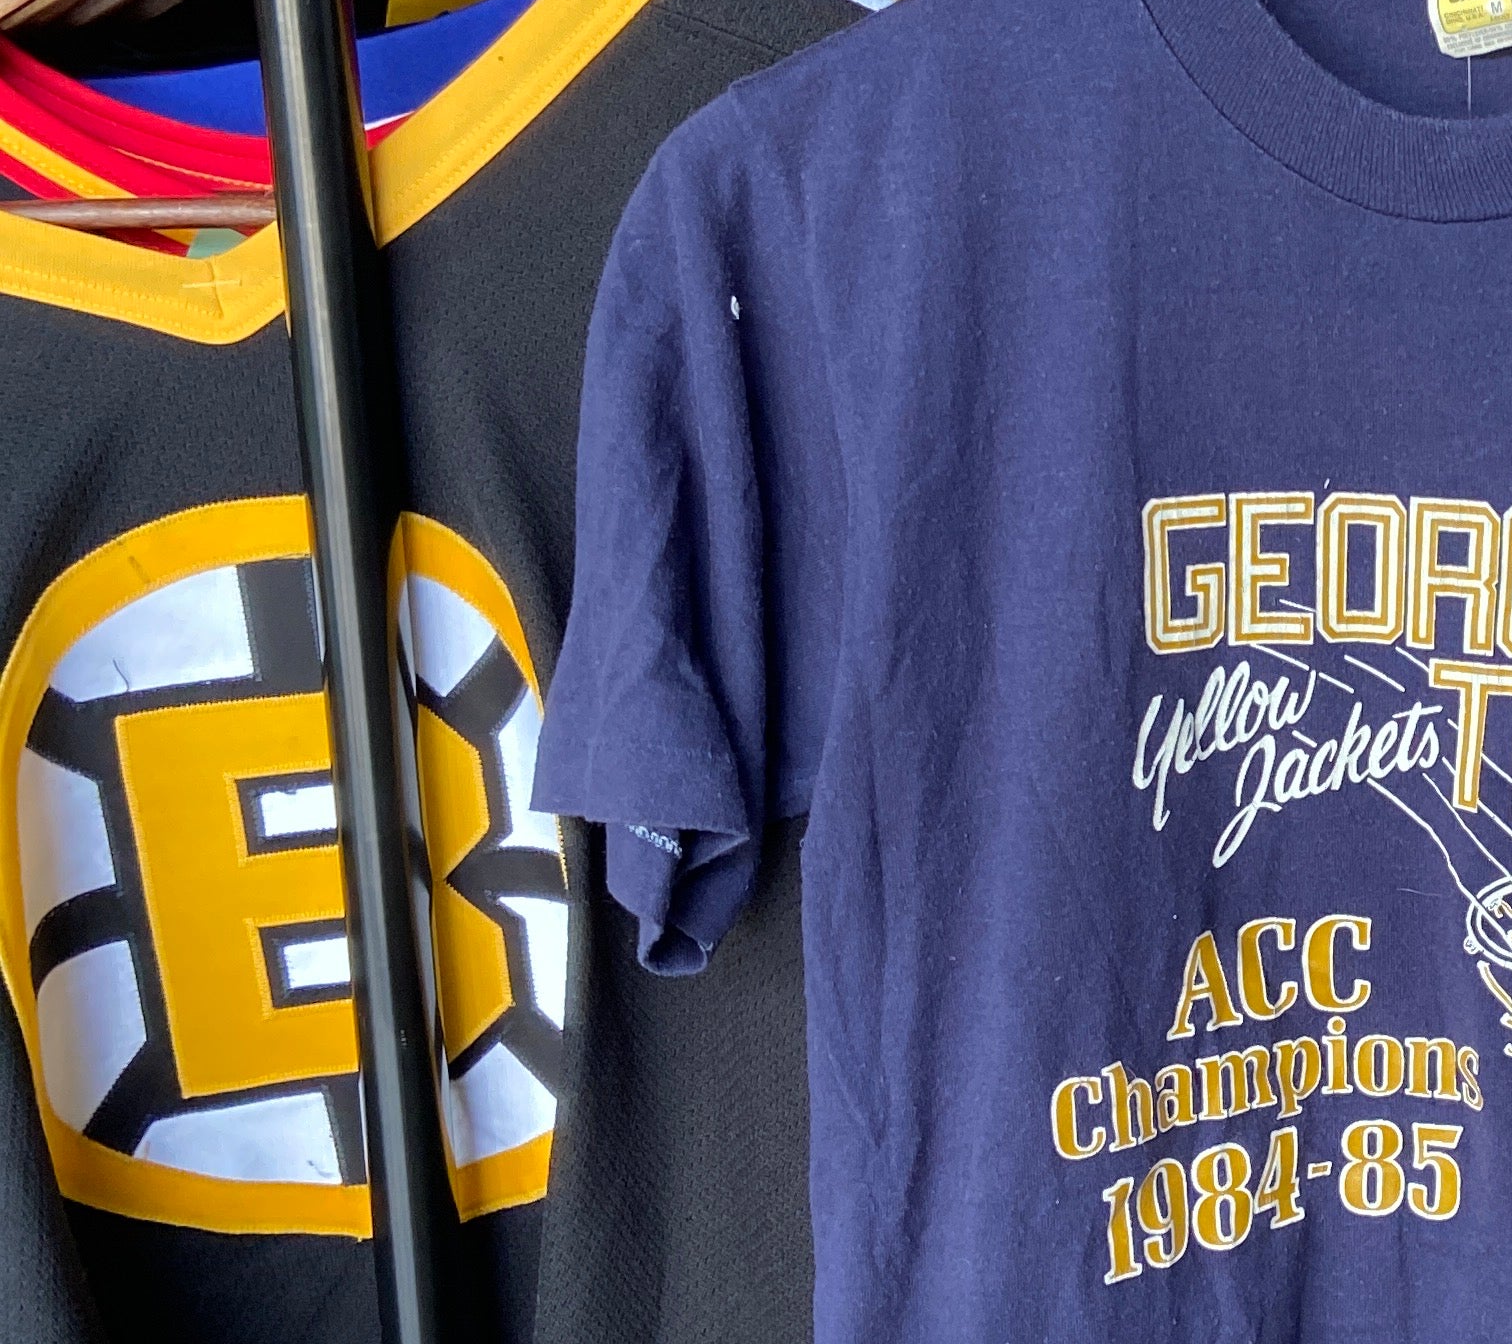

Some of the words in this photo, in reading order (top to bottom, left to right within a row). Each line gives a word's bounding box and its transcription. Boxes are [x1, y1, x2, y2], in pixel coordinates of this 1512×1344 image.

[1490, 0, 1503, 14] M
[1132, 660, 1316, 831] Yellow
[1213, 702, 1443, 868] Jackets
[1166, 914, 1372, 1041] ACC
[1051, 1015, 1484, 1160] Champions
[1103, 1119, 1464, 1286] 1984-85
